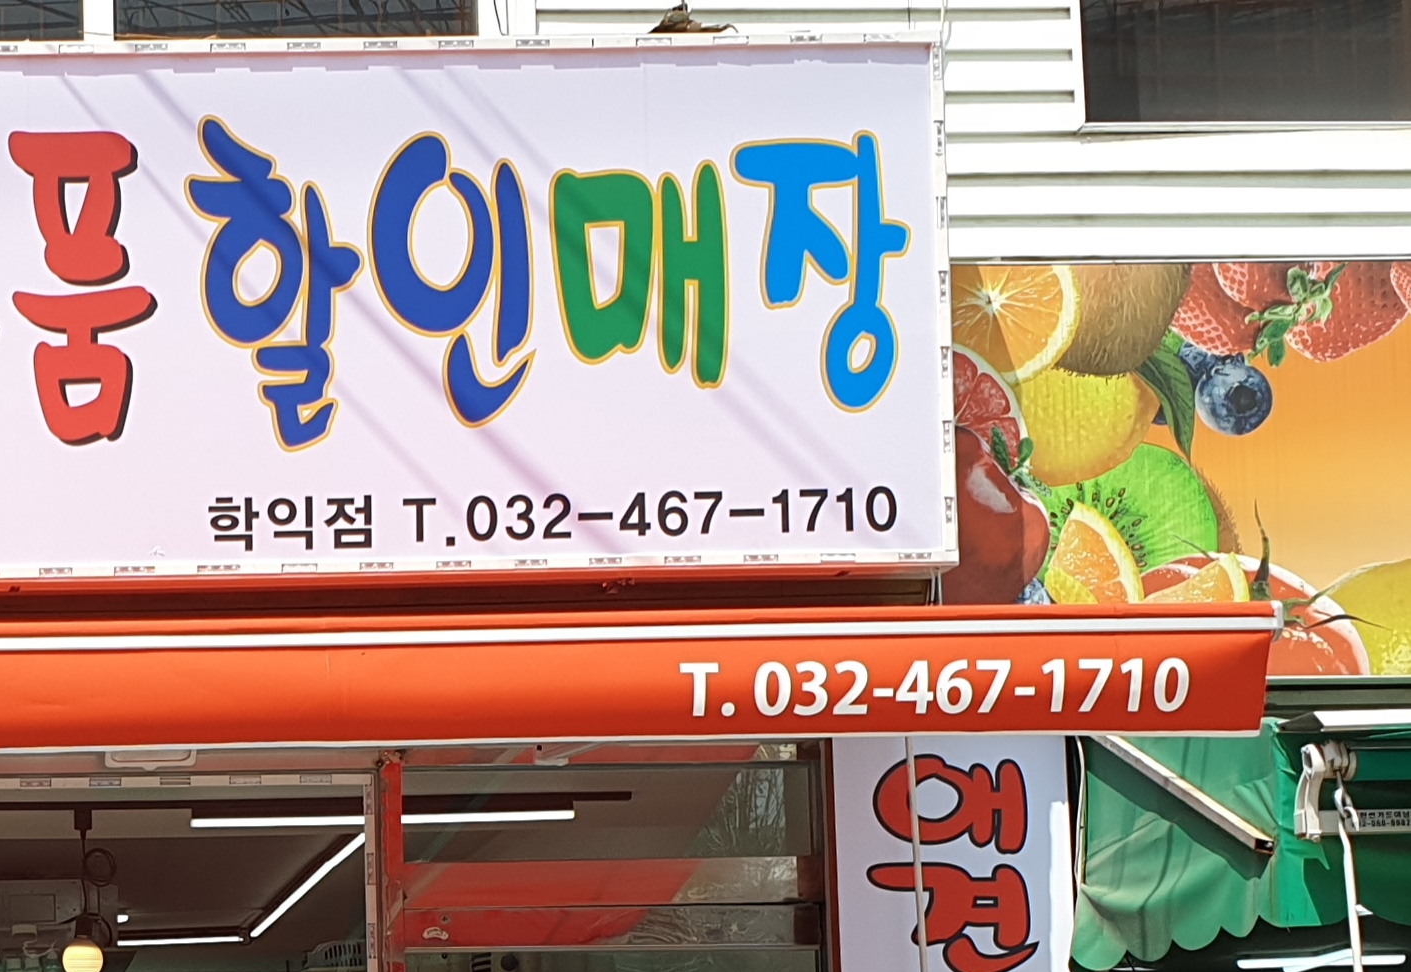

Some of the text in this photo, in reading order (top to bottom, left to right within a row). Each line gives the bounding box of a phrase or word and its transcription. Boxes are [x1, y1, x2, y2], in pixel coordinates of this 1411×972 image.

[184, 115, 910, 450] 할인매장
[208, 494, 375, 550] 학익점
[754, 657, 1190, 716] 032-467-1710
